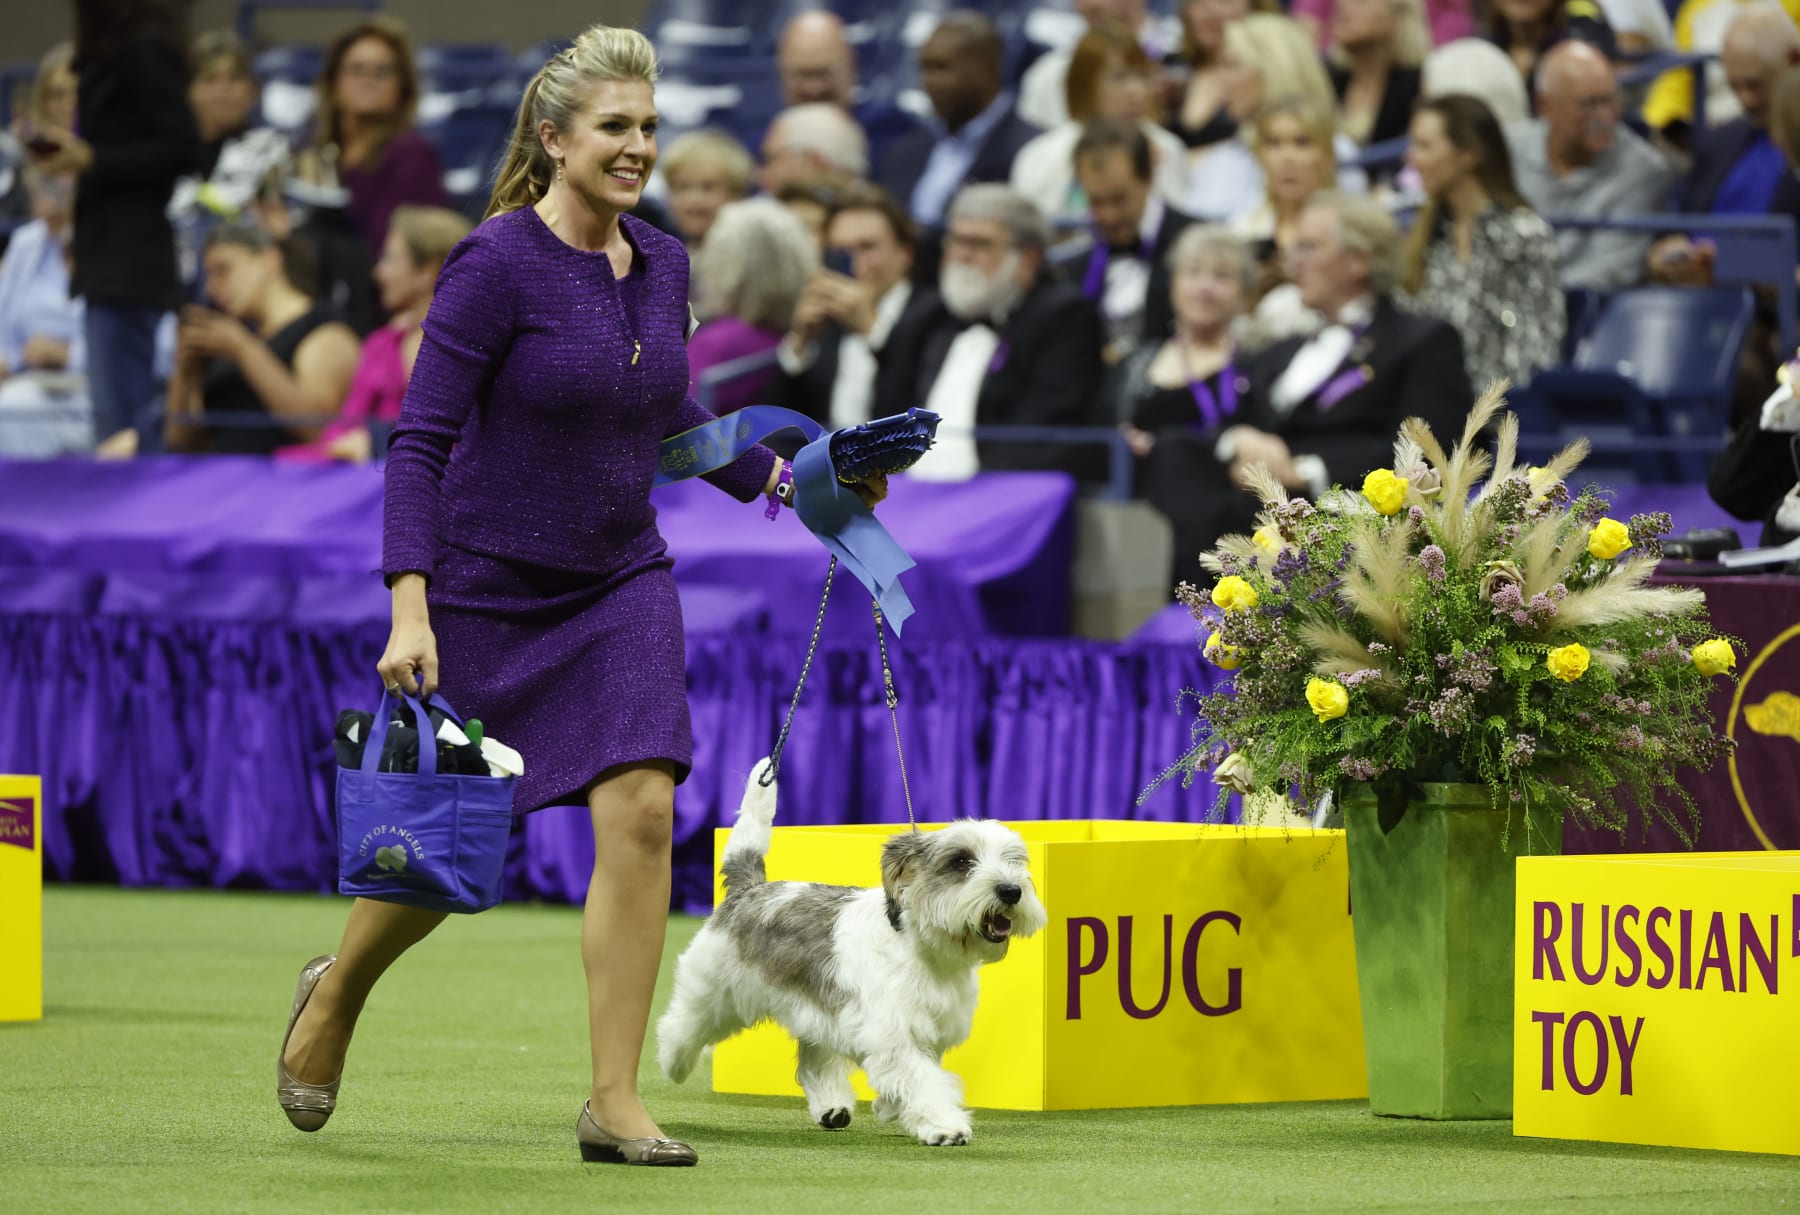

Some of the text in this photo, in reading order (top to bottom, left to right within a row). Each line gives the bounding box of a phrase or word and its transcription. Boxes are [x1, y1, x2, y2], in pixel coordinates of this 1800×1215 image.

[360, 825, 425, 860] CITY OF ANGELS
[1066, 910, 1243, 1021] PUG
[1532, 901, 1779, 996] RUSSIAN
[1532, 1010, 1645, 1097] TOY
